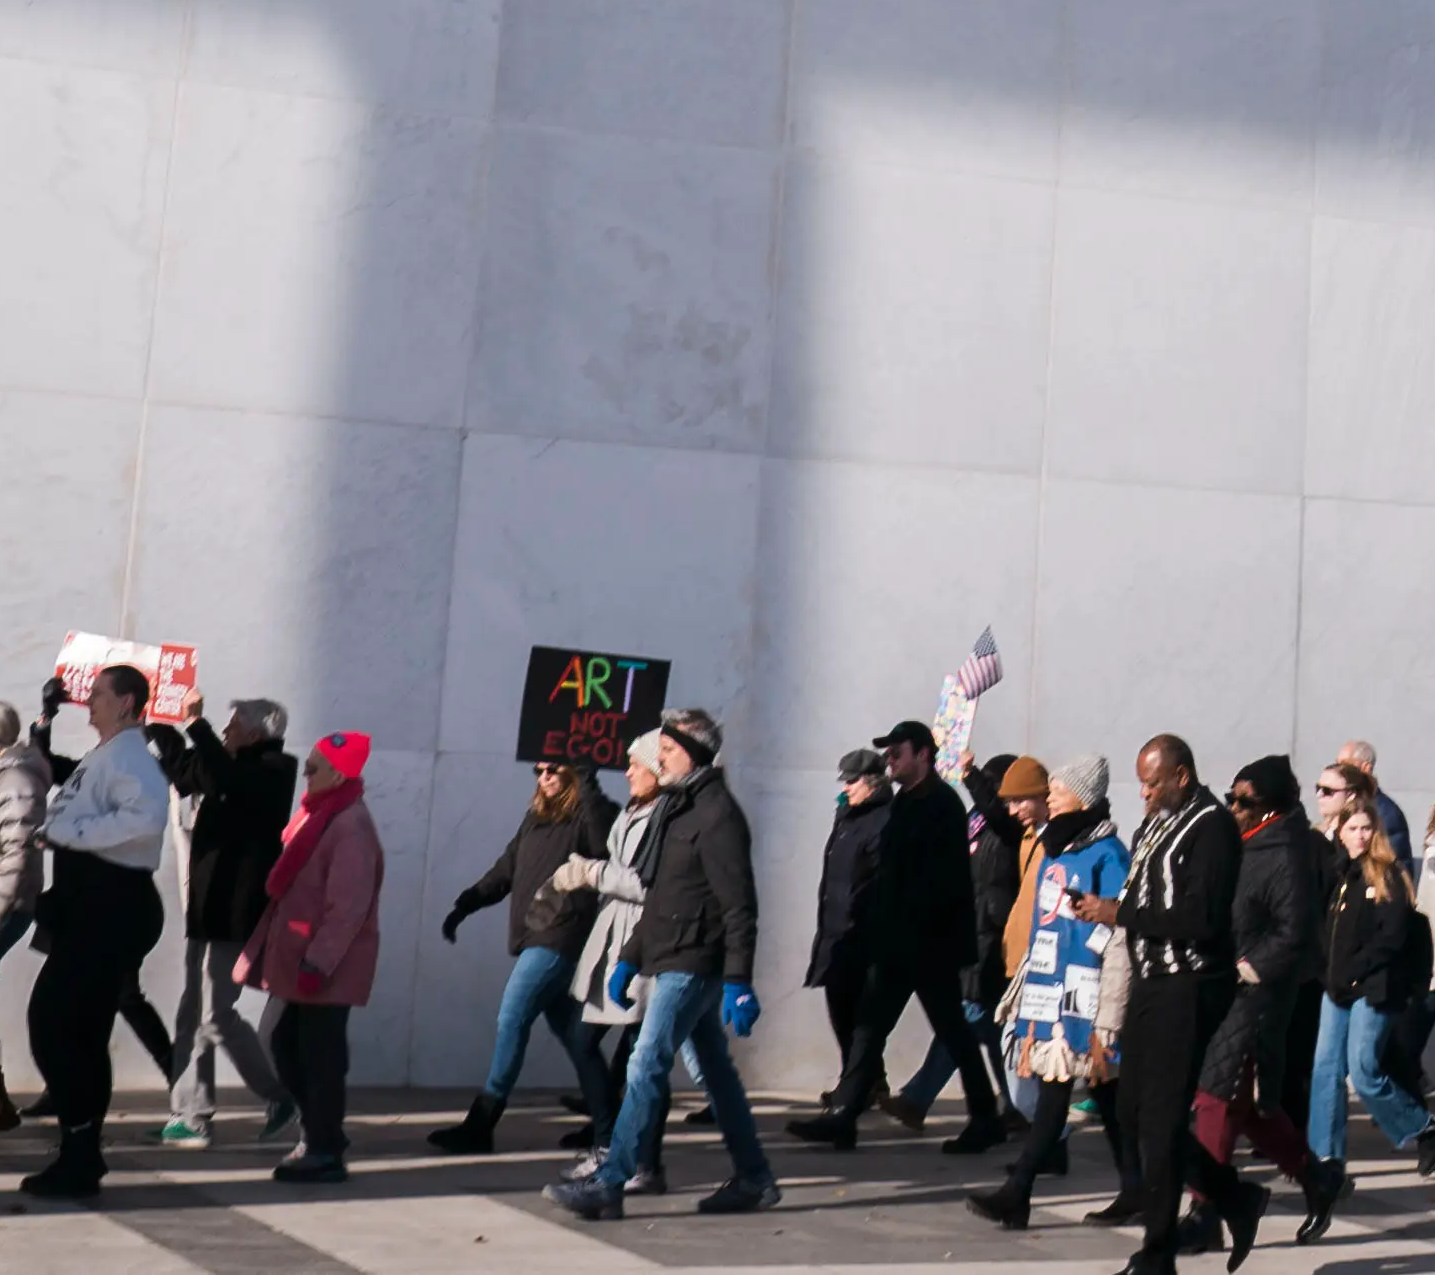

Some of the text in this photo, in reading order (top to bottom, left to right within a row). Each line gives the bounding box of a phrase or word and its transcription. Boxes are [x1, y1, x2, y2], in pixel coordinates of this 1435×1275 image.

[549, 655, 649, 714] ART
[570, 711, 628, 739] NOT
[543, 730, 625, 766] EGO!
